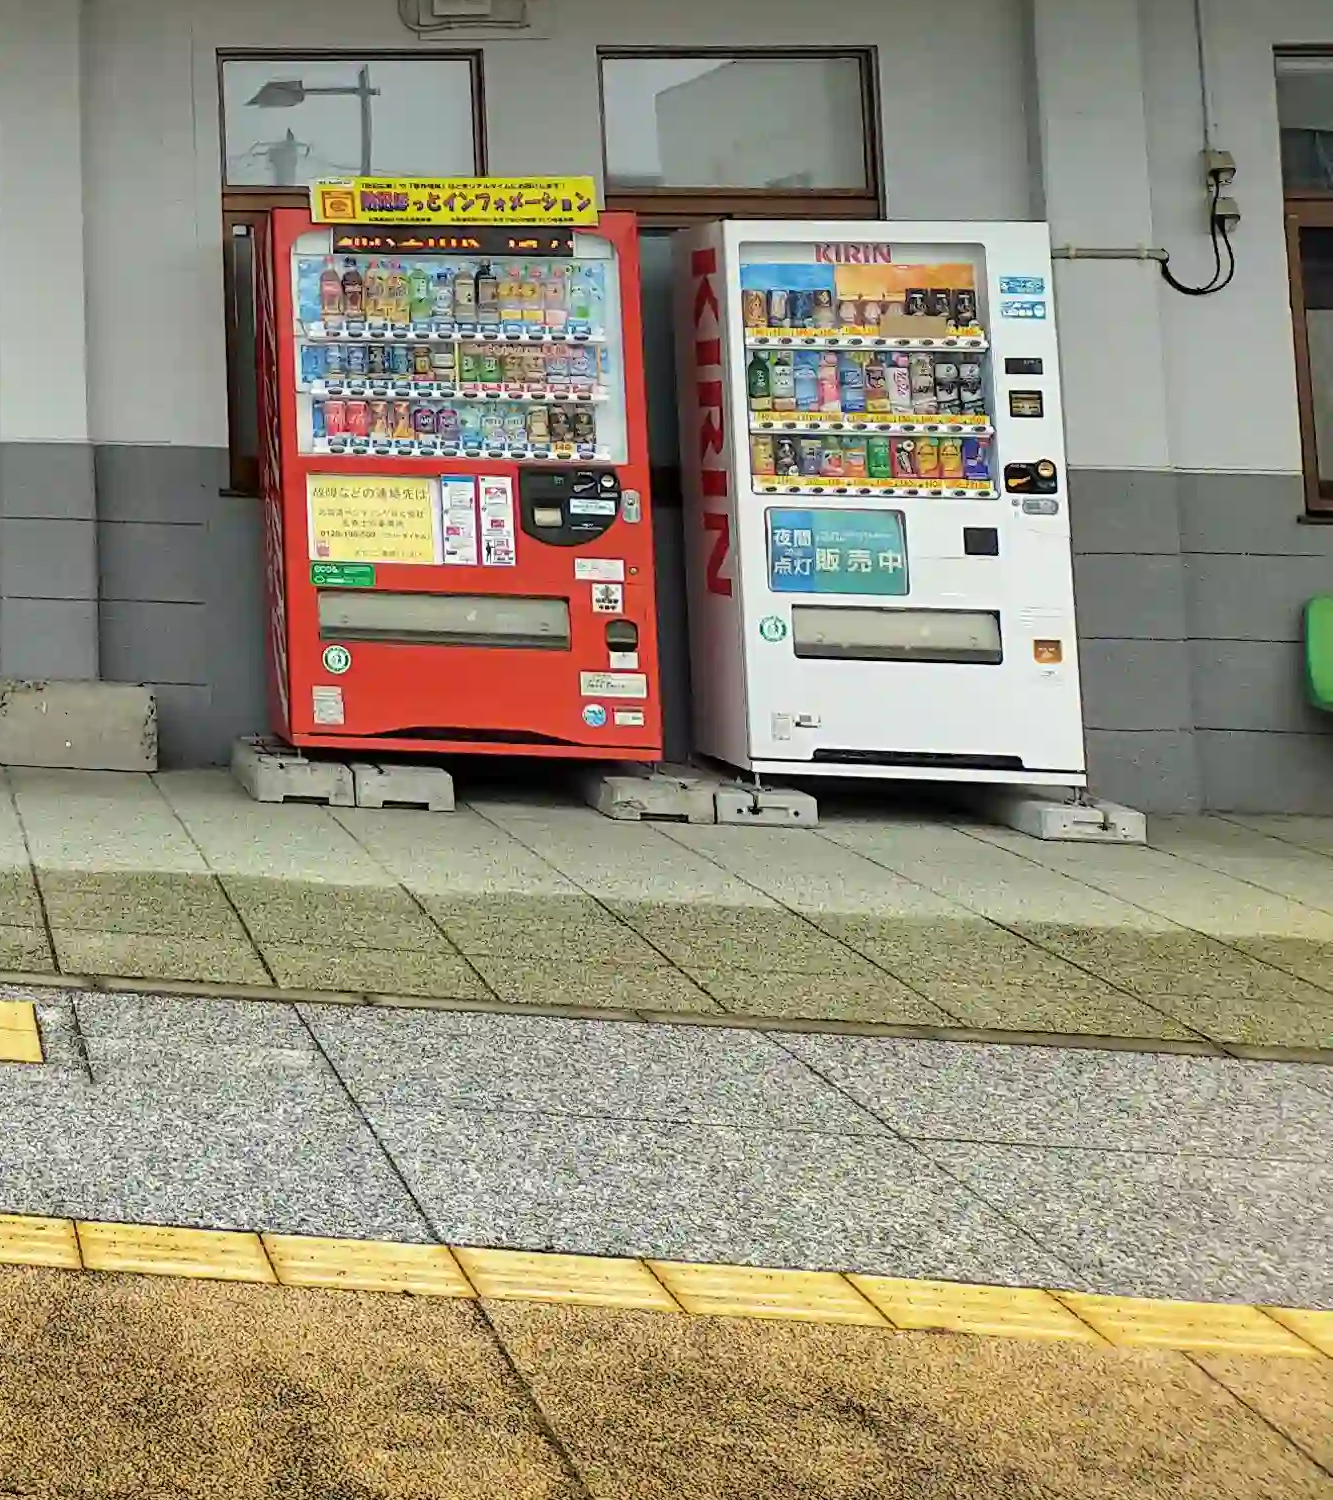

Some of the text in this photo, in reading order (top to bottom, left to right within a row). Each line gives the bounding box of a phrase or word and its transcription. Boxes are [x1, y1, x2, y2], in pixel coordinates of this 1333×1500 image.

[814, 243, 892, 263] KIRIN
[691, 248, 733, 597] KIRIN
[773, 556, 813, 576] 点灯
[815, 547, 903, 574] 販売中
